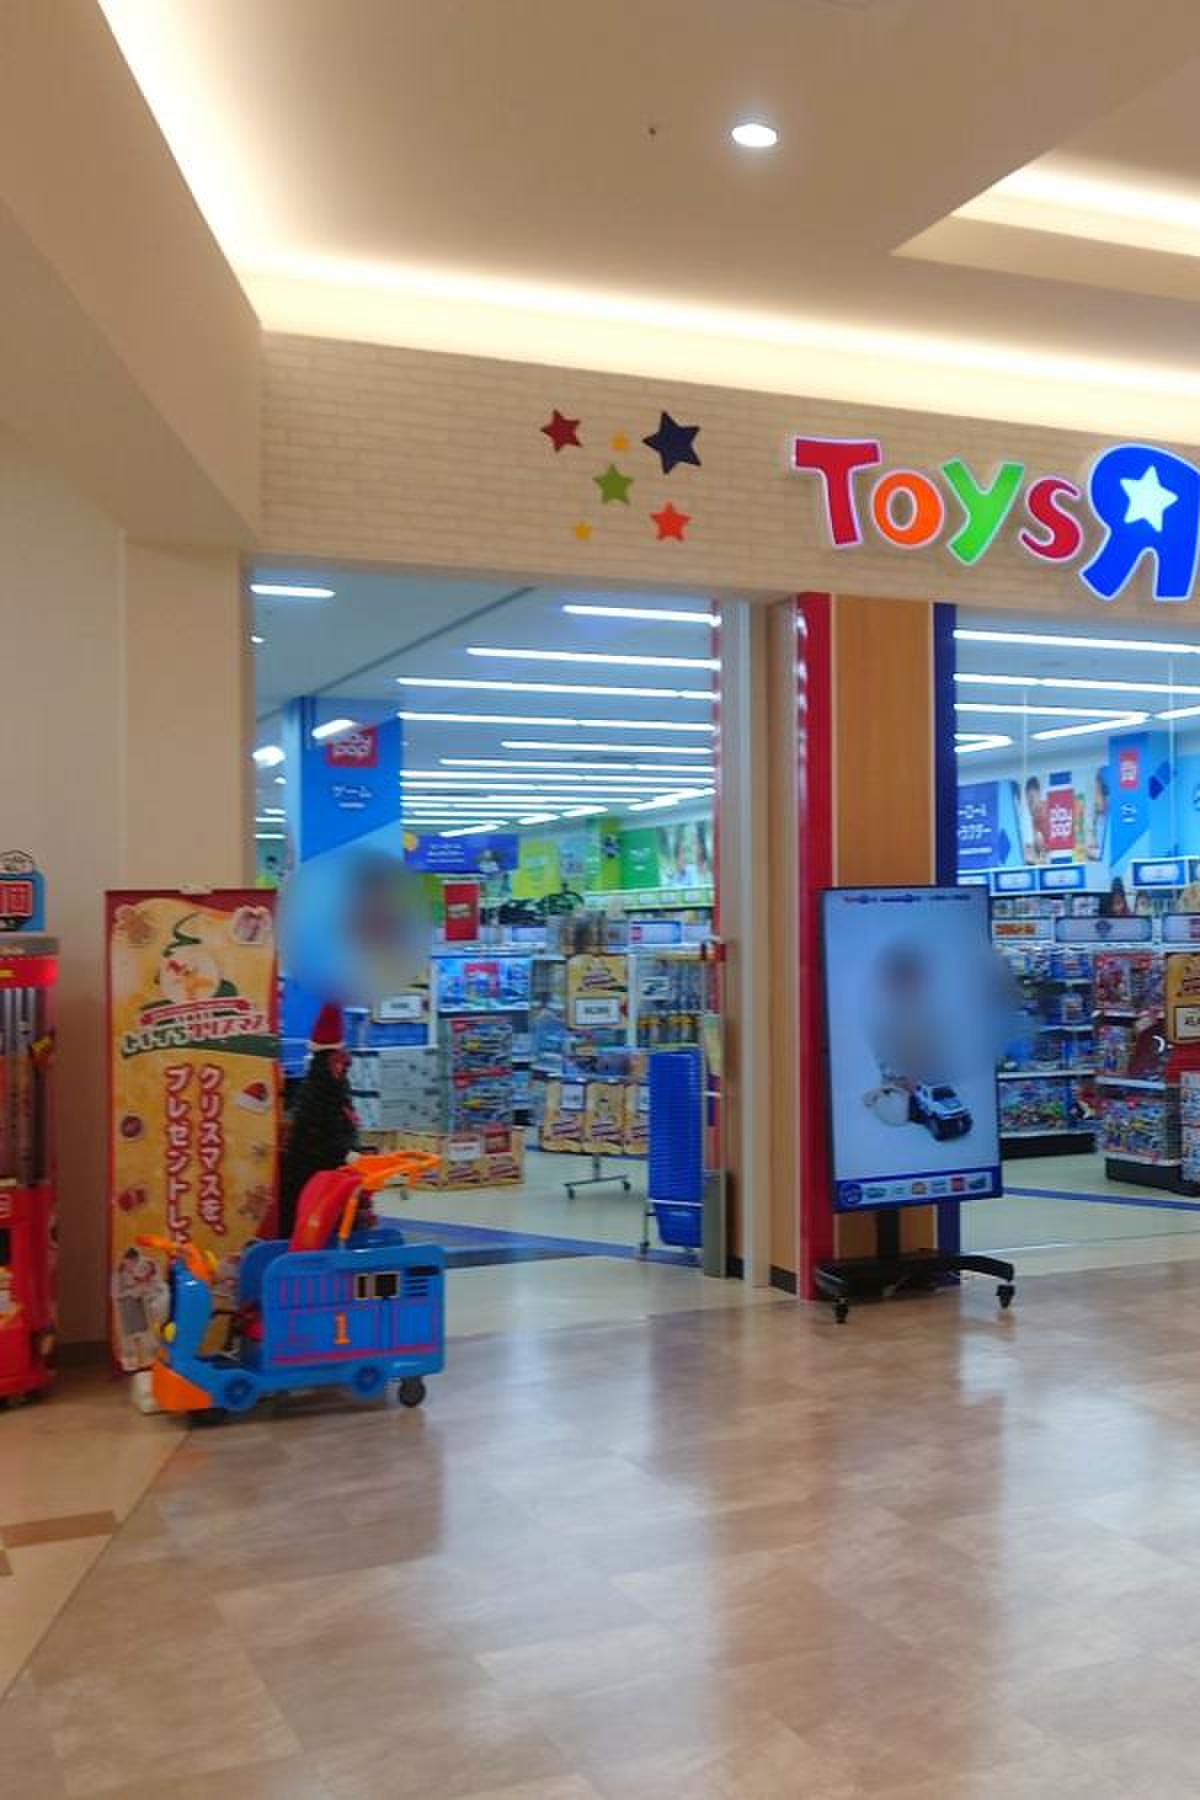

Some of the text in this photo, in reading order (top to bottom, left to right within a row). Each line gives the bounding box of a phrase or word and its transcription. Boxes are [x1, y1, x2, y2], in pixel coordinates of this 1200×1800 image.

[200, 1065, 225, 1234] クリスマスを、
[333, 1311, 350, 1344] 1
